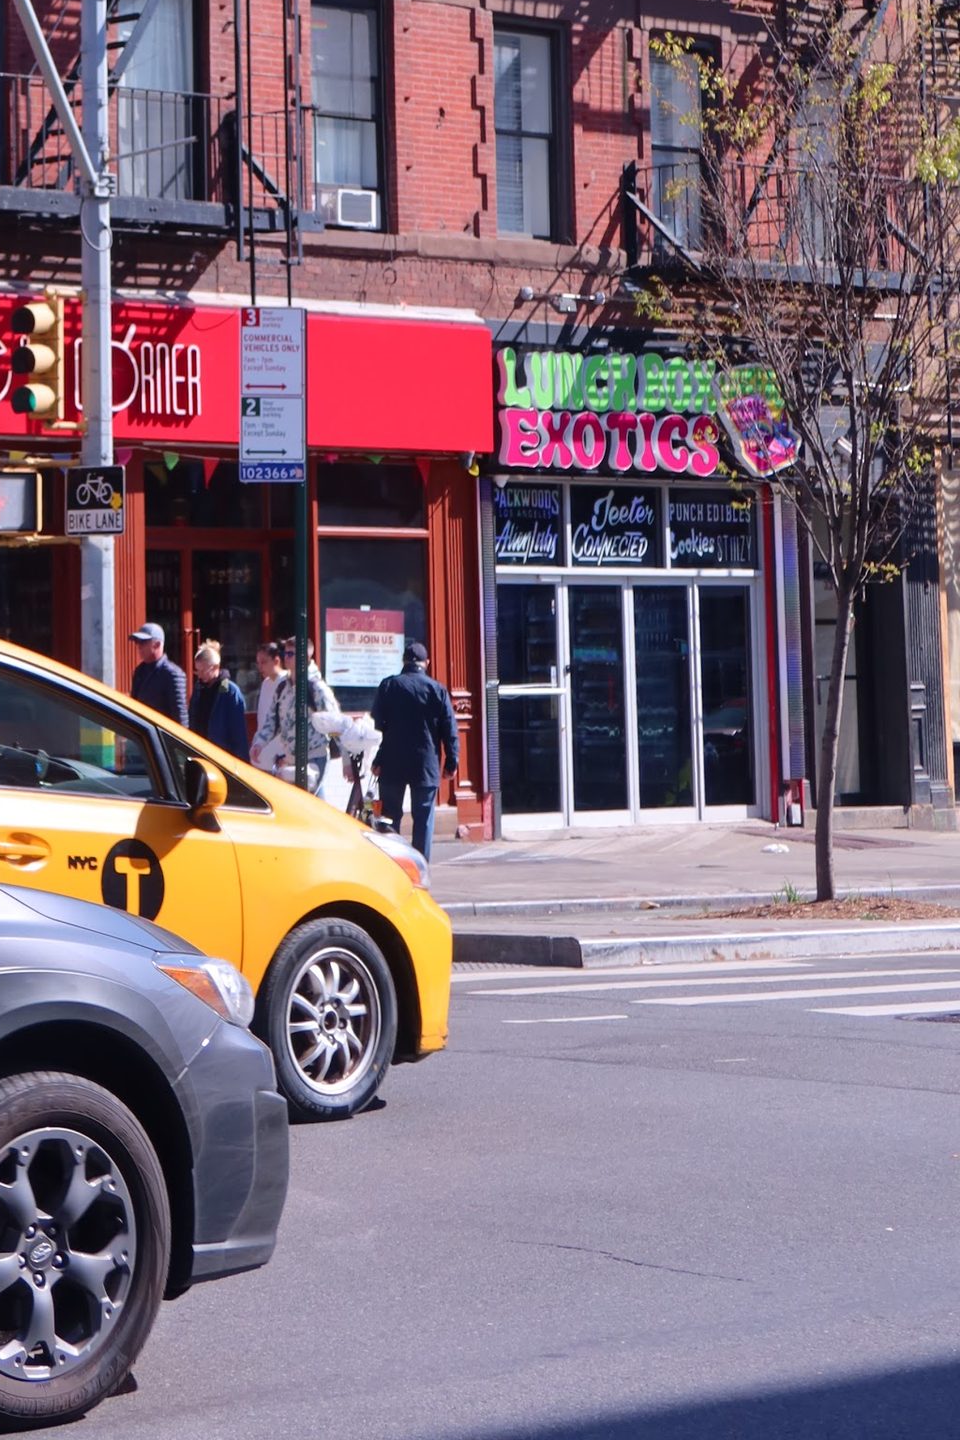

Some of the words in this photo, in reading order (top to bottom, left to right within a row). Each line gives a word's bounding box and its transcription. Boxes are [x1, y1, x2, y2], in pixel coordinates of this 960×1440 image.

[245, 309, 257, 326] 3
[243, 334, 293, 343] COMMERCIAL
[244, 344, 280, 353] VEHICLES
[281, 344, 300, 353] ONLY
[246, 399, 257, 416] 2
[498, 408, 720, 477] EXOTICS
[242, 467, 288, 479] 102366
[591, 489, 655, 531] Jeeter
[669, 503, 704, 522] PUNCH
[707, 503, 751, 524] EDIBLES
[69, 513, 91, 530] BIKE
[95, 512, 121, 529] LANE
[572, 523, 649, 566] CONNECTED
[670, 528, 715, 559] Cookies
[358, 634, 380, 645] JOIN
[381, 635, 393, 645] US
[68, 855, 98, 871] NYC
